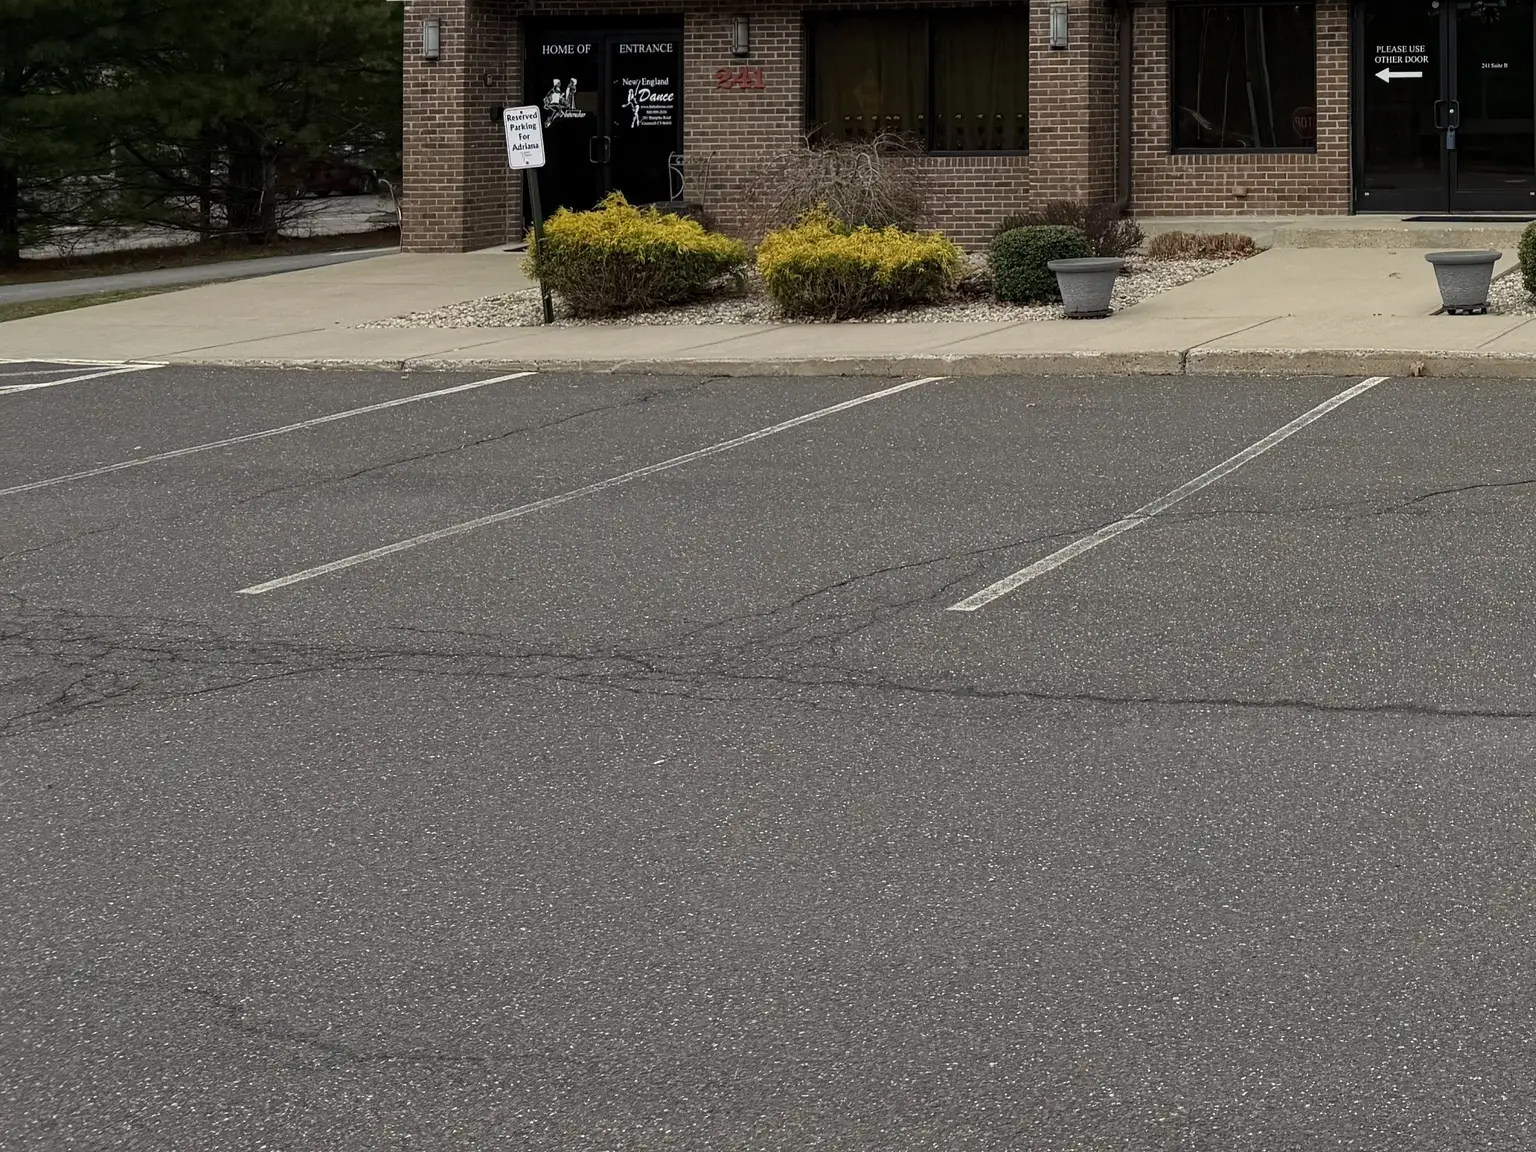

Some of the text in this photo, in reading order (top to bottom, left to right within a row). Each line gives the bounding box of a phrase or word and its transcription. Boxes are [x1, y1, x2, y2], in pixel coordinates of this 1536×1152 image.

[542, 43, 592, 54] HOME OF
[619, 43, 674, 54] ENTRANCE
[1376, 44, 1426, 54] PLEASE USE
[1374, 55, 1429, 64] OTHER DOOR
[622, 77, 669, 87] New England
[715, 67, 766, 89] 241
[638, 88, 674, 102] Dance
[506, 111, 538, 122] Reserved
[509, 122, 537, 132] Parking
[518, 133, 530, 141] For
[512, 142, 540, 152] Adriana
